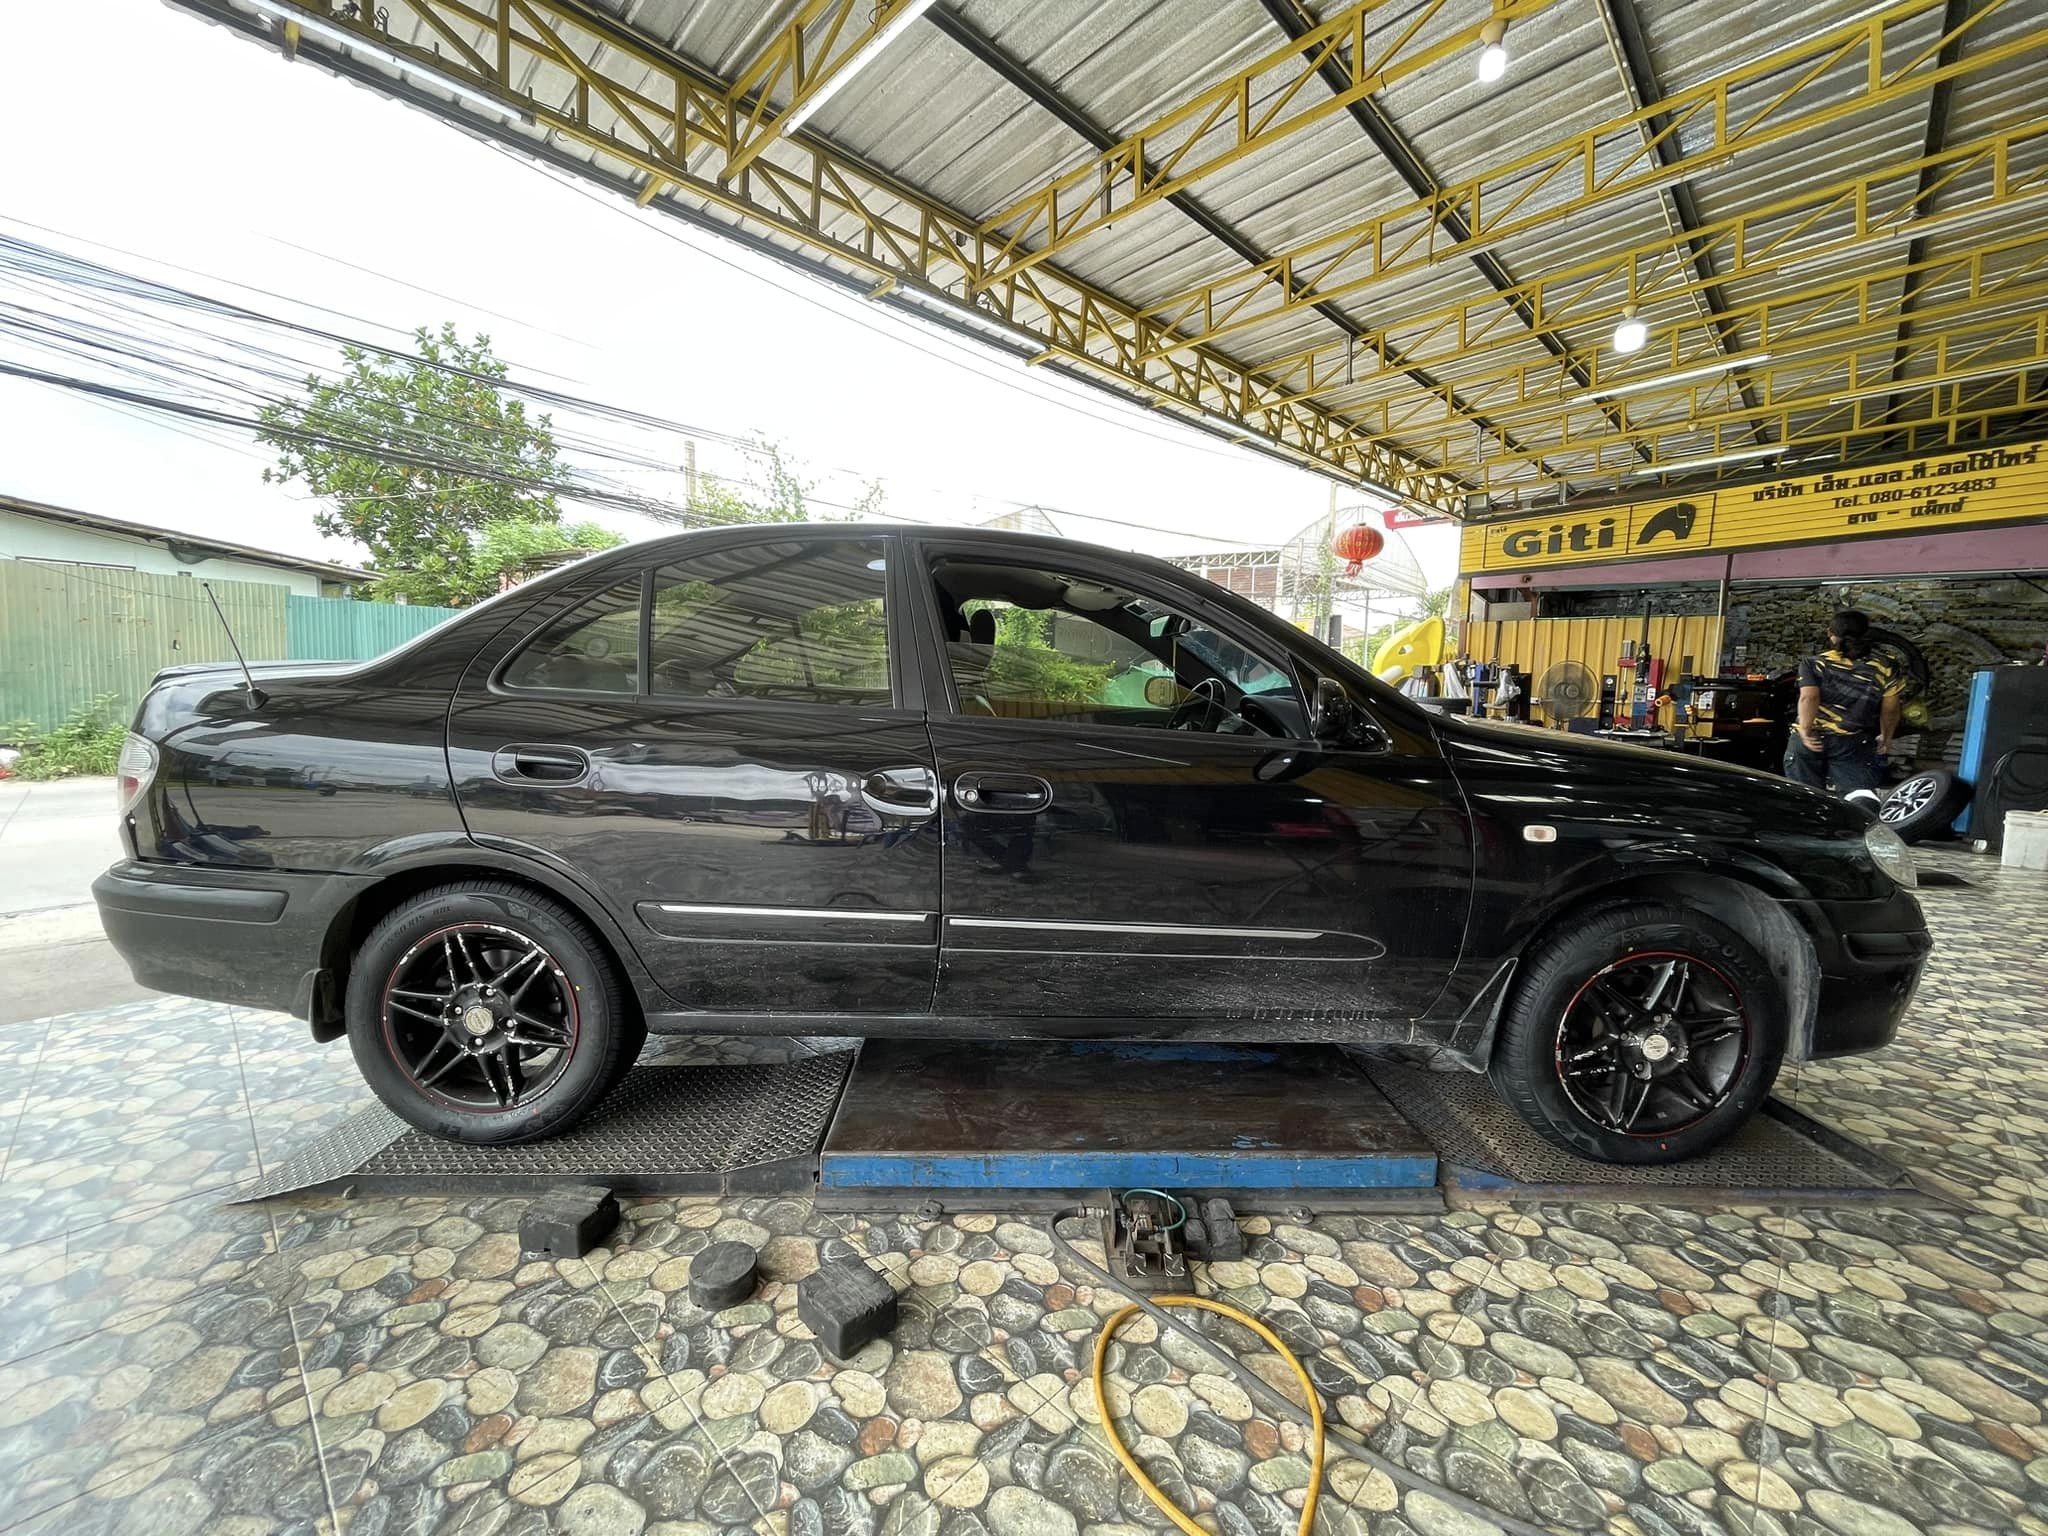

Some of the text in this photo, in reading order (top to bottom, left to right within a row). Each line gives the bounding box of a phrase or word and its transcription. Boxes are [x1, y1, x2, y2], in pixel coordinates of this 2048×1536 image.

[1753, 481, 1803, 502] บริษัท
[1831, 477, 1998, 509] Tel. 080-6123483
[1847, 511, 1878, 525] ยาง
[1503, 518, 1616, 558] Giti
